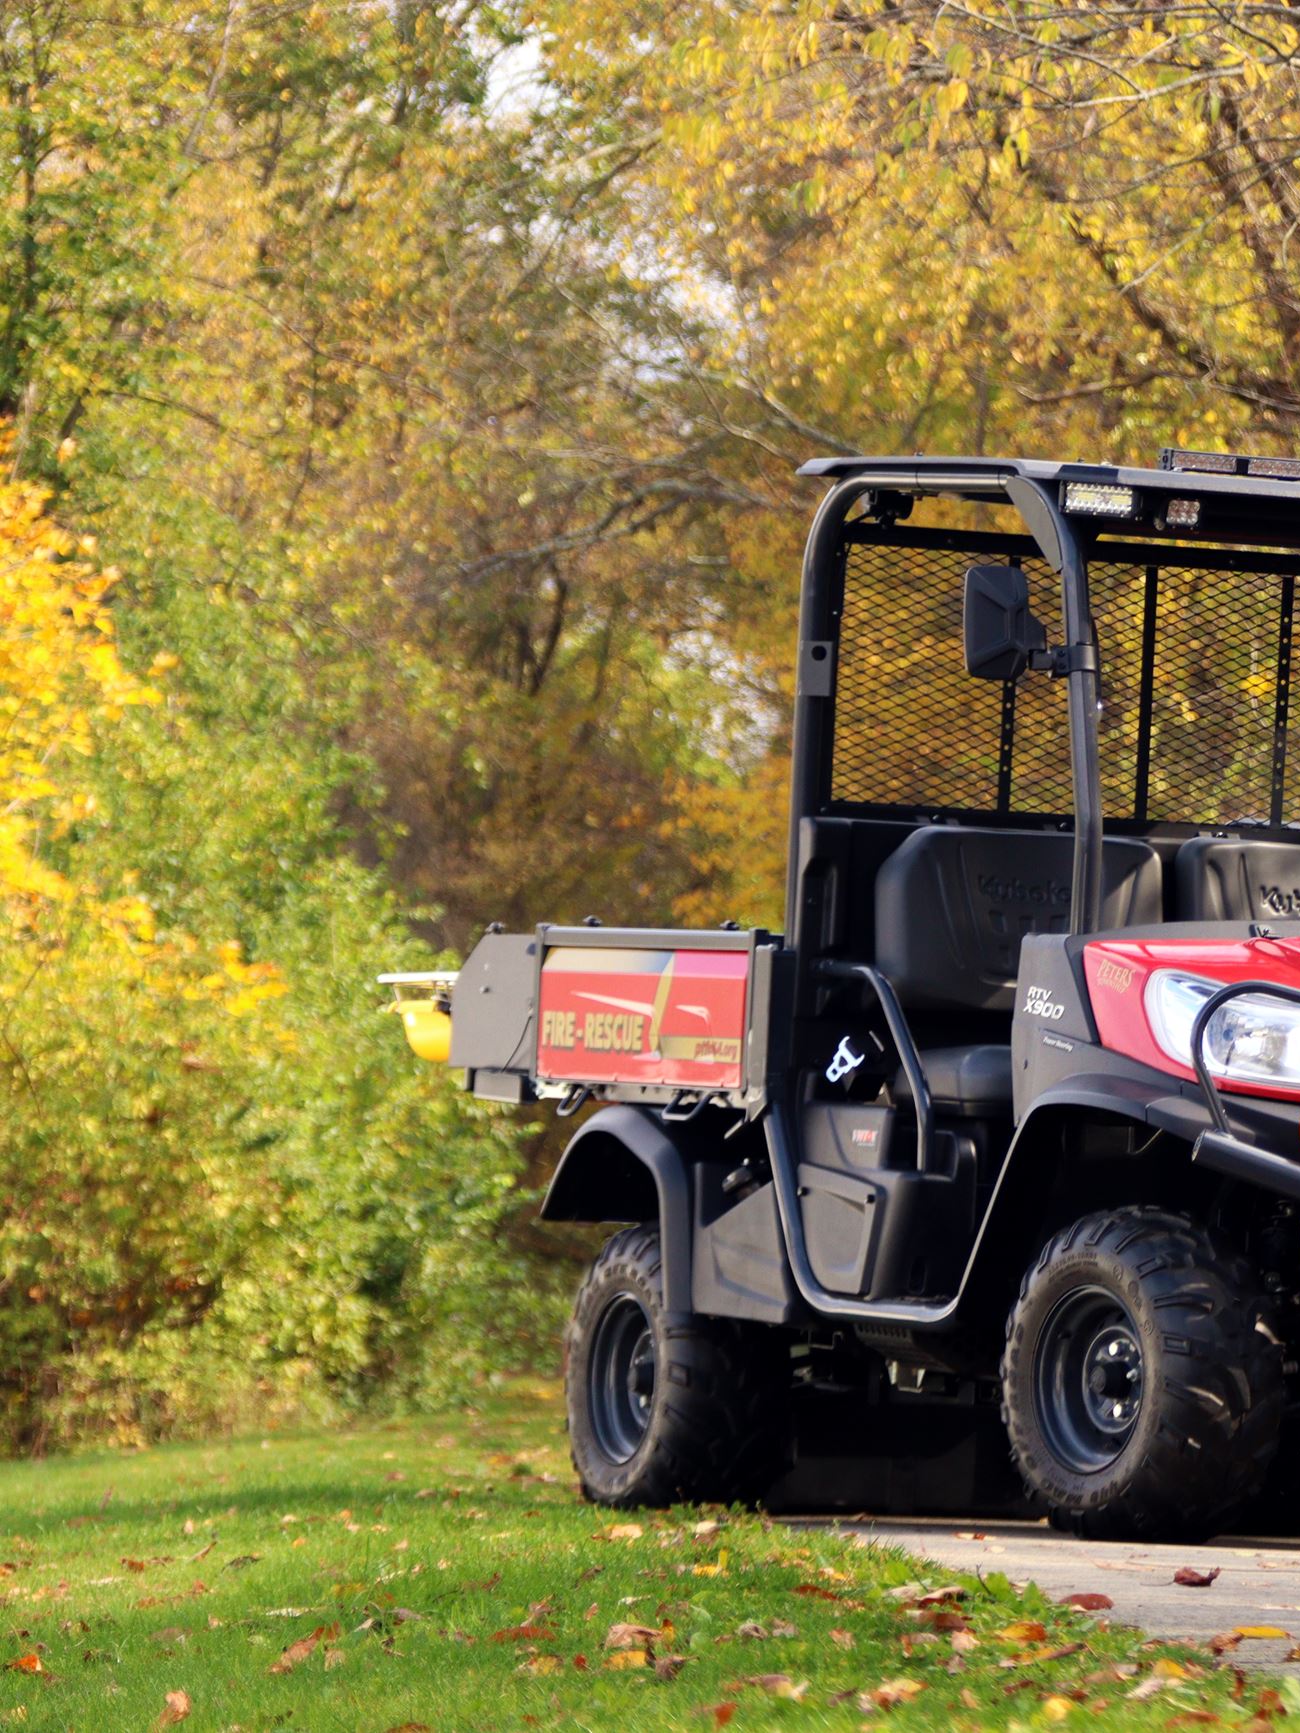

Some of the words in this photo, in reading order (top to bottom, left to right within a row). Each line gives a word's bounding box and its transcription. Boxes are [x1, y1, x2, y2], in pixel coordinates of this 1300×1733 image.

[1096, 958, 1137, 987] PETERS
[1027, 985, 1052, 1001] RTV
[1022, 997, 1065, 1021] X900
